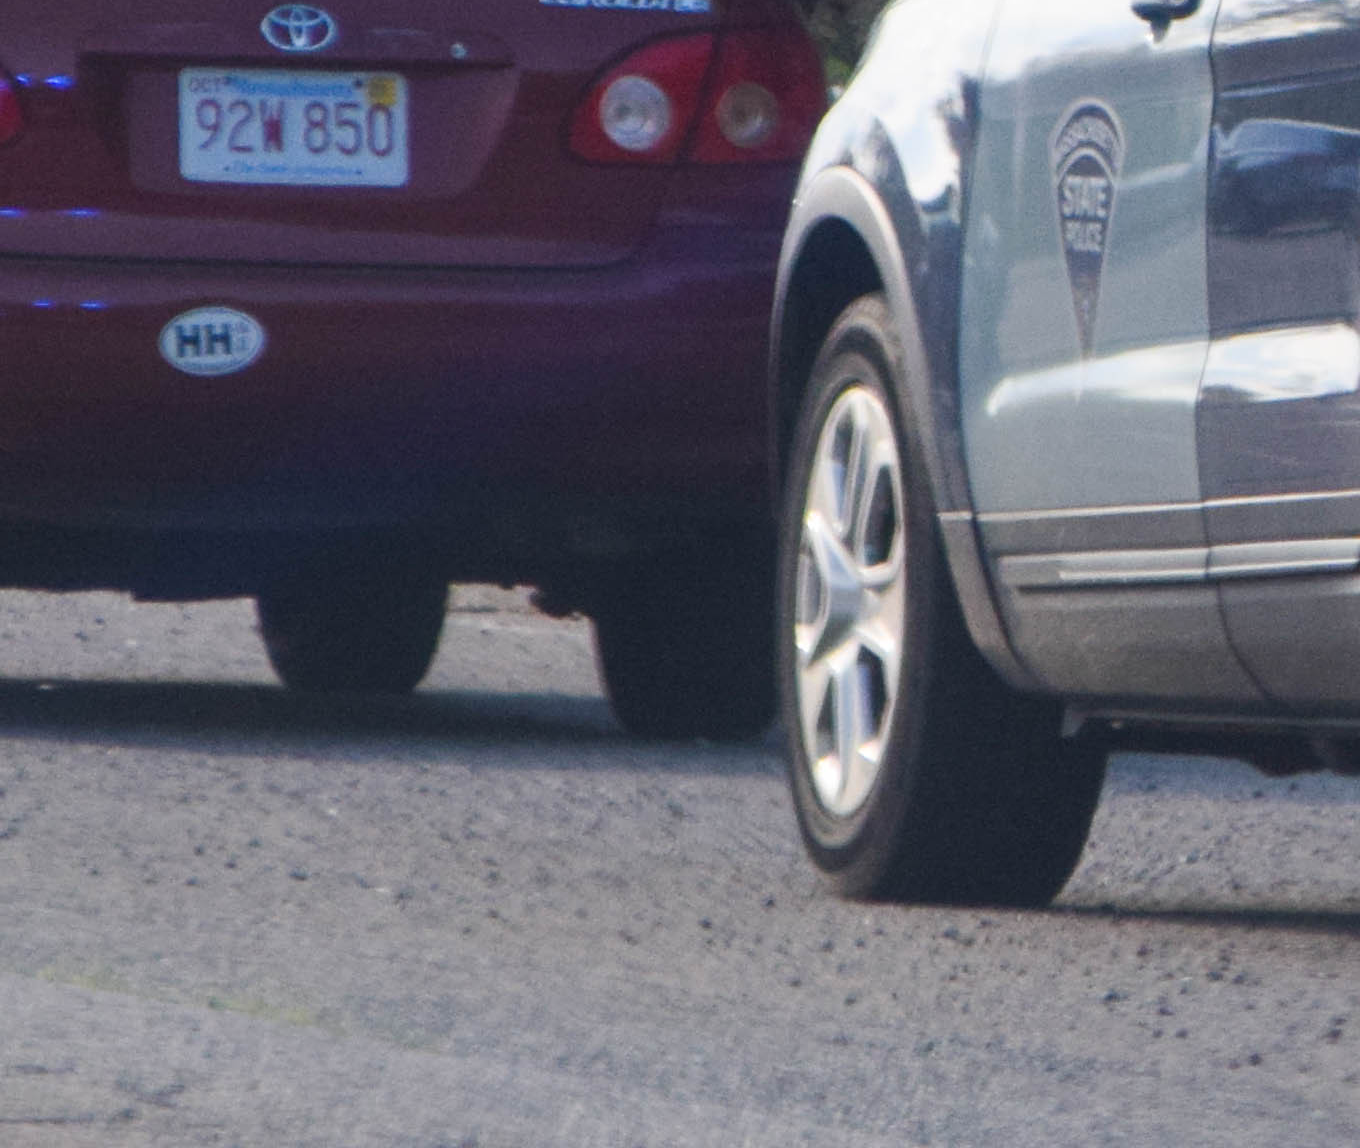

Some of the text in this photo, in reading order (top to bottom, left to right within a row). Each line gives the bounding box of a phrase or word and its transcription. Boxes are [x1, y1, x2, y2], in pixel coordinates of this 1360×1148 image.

[303, 101, 394, 157] 850
[1062, 174, 1109, 219] STATE
[1064, 219, 1105, 253] POLICE
[175, 323, 232, 358] HH
